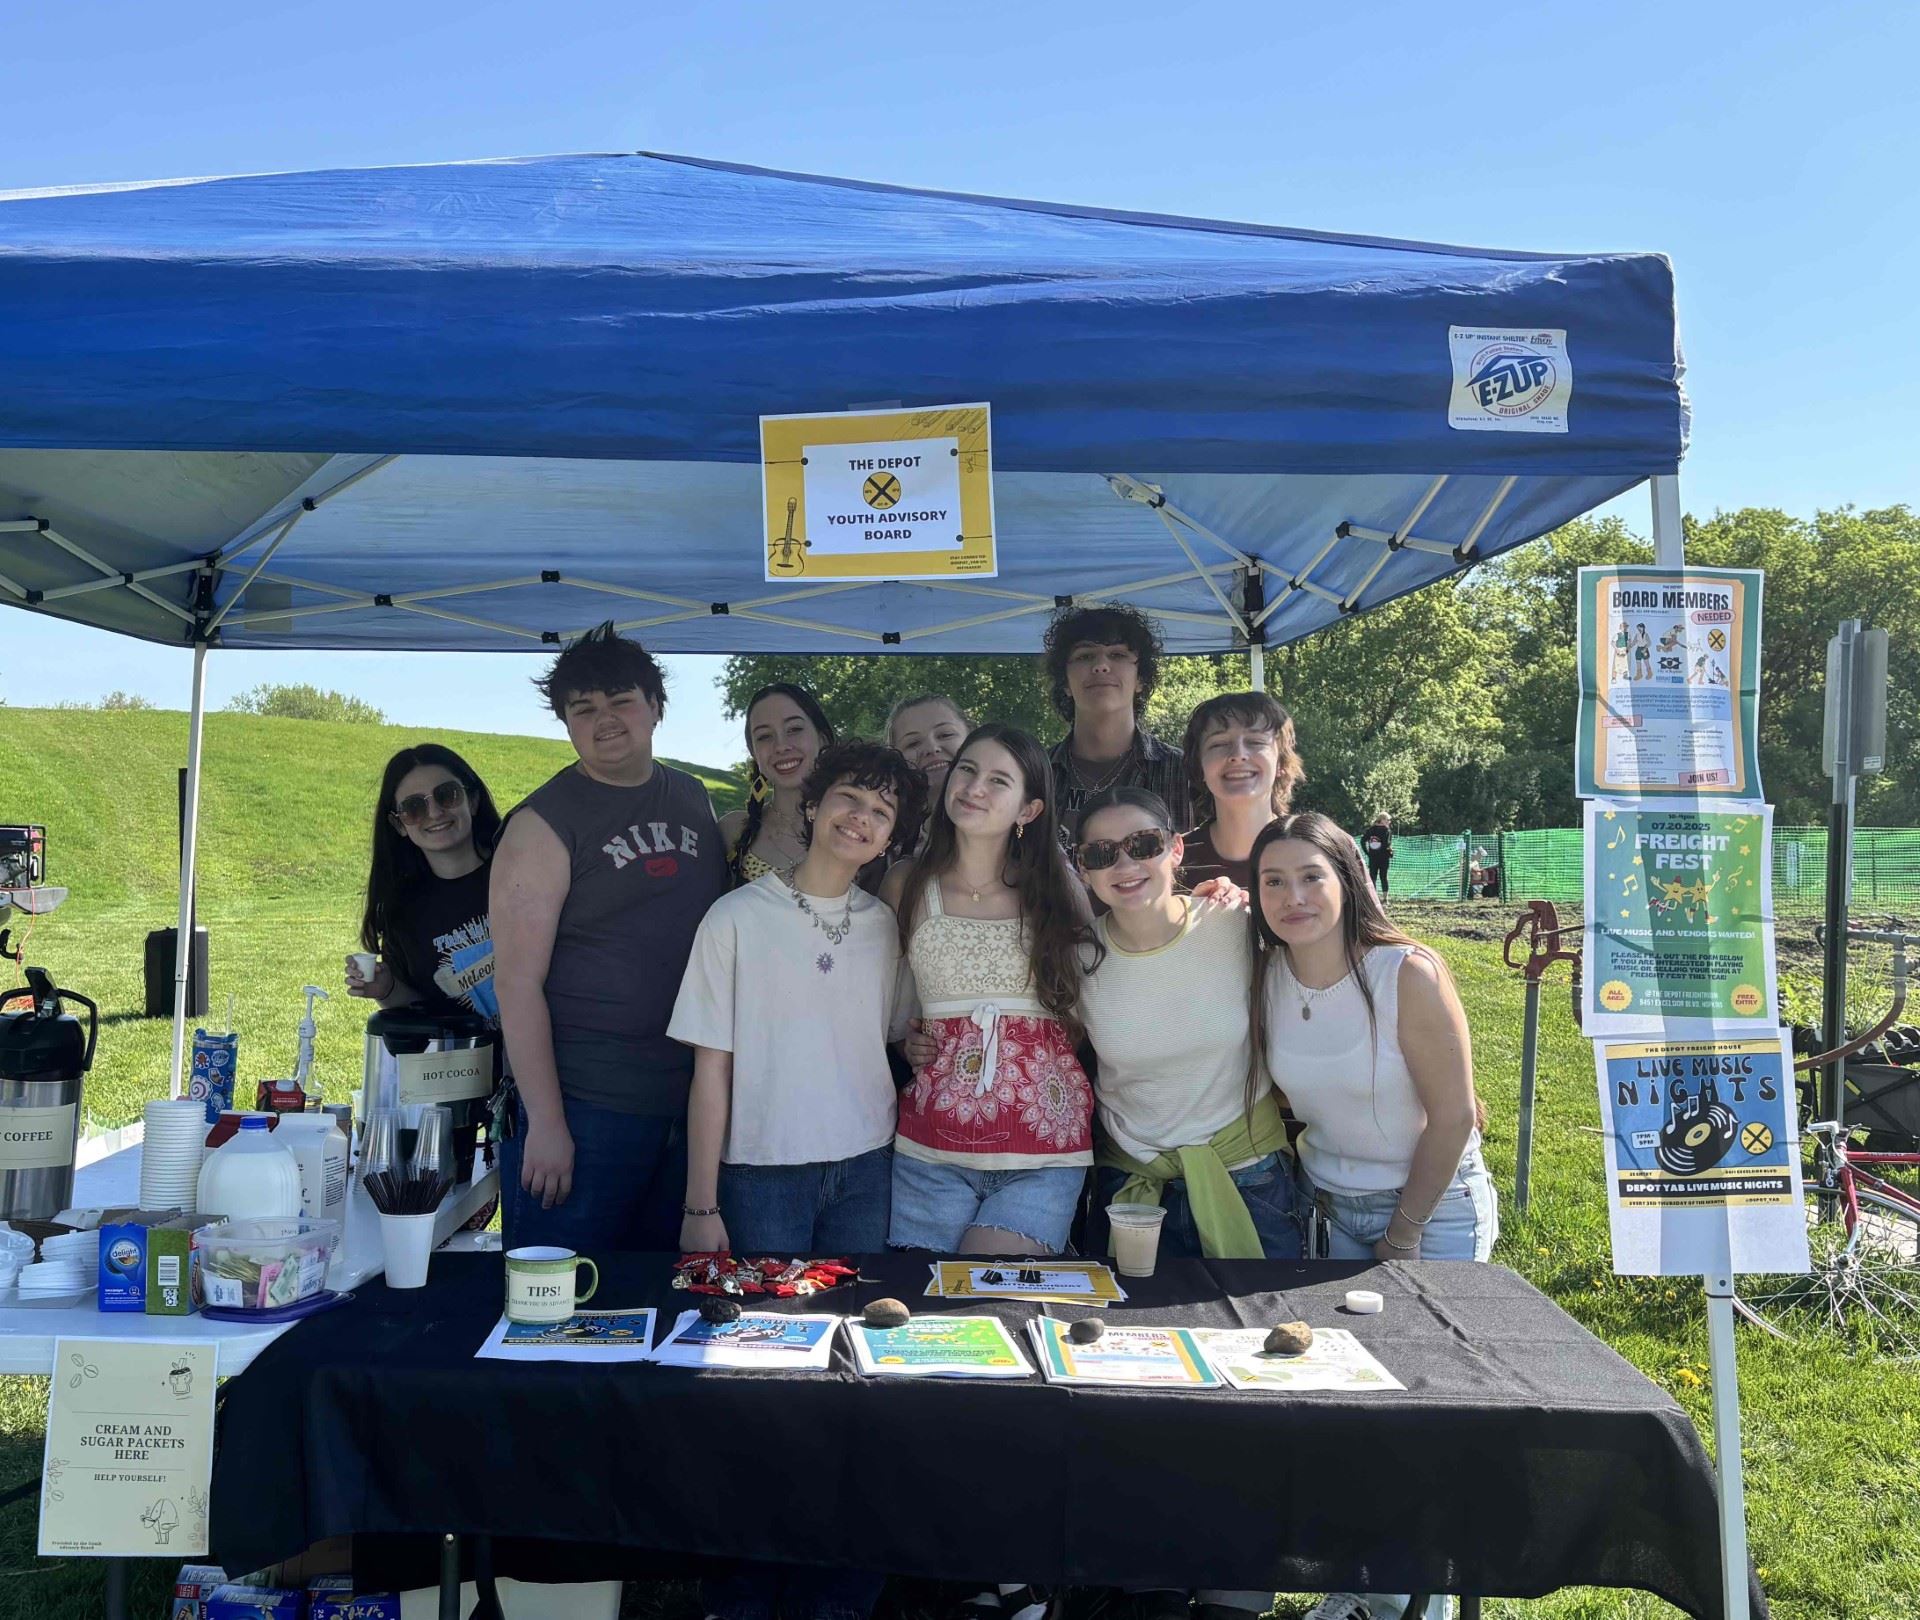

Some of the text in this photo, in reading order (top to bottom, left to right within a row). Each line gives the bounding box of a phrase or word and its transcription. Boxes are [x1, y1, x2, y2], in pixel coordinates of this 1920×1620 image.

[1499, 385, 1551, 415] ORIGINAL SHADE
[848, 456, 922, 471] THE DEPOT
[827, 510, 948, 525] YOUTH ADVISORY
[864, 529, 912, 541] BOARD
[1613, 591, 1729, 610] BOARD MEMBERS
[1697, 613, 1731, 622] NEEDED
[1688, 772, 1719, 784] JOIN US!
[1651, 822, 1711, 831] 07.20.2025
[602, 822, 699, 869] NIKE
[1635, 833, 1730, 851] FREIGHT
[1656, 853, 1712, 870] FEST
[1601, 928, 1622, 936] LIVE
[1623, 928, 1653, 936] MUSIC
[1677, 930, 1717, 938] VENDORS
[1718, 931, 1755, 939] WANTED!
[1637, 1056, 1753, 1078] LIVE MUSIC
[422, 1067, 481, 1081] HOT COCOA
[4, 1130, 53, 1142] COFFEE
[1626, 1180, 1784, 1192] DEPOT YAB LIVE MUSIC NIGHTS
[112, 1247, 137, 1258] delight
[526, 1285, 561, 1297] TIPS!
[95, 1424, 172, 1436] CREAM AND
[80, 1436, 185, 1449] SUGAR PACKETS
[114, 1450, 150, 1460] HERE
[118, 1474, 167, 1482] YOURSELF!
